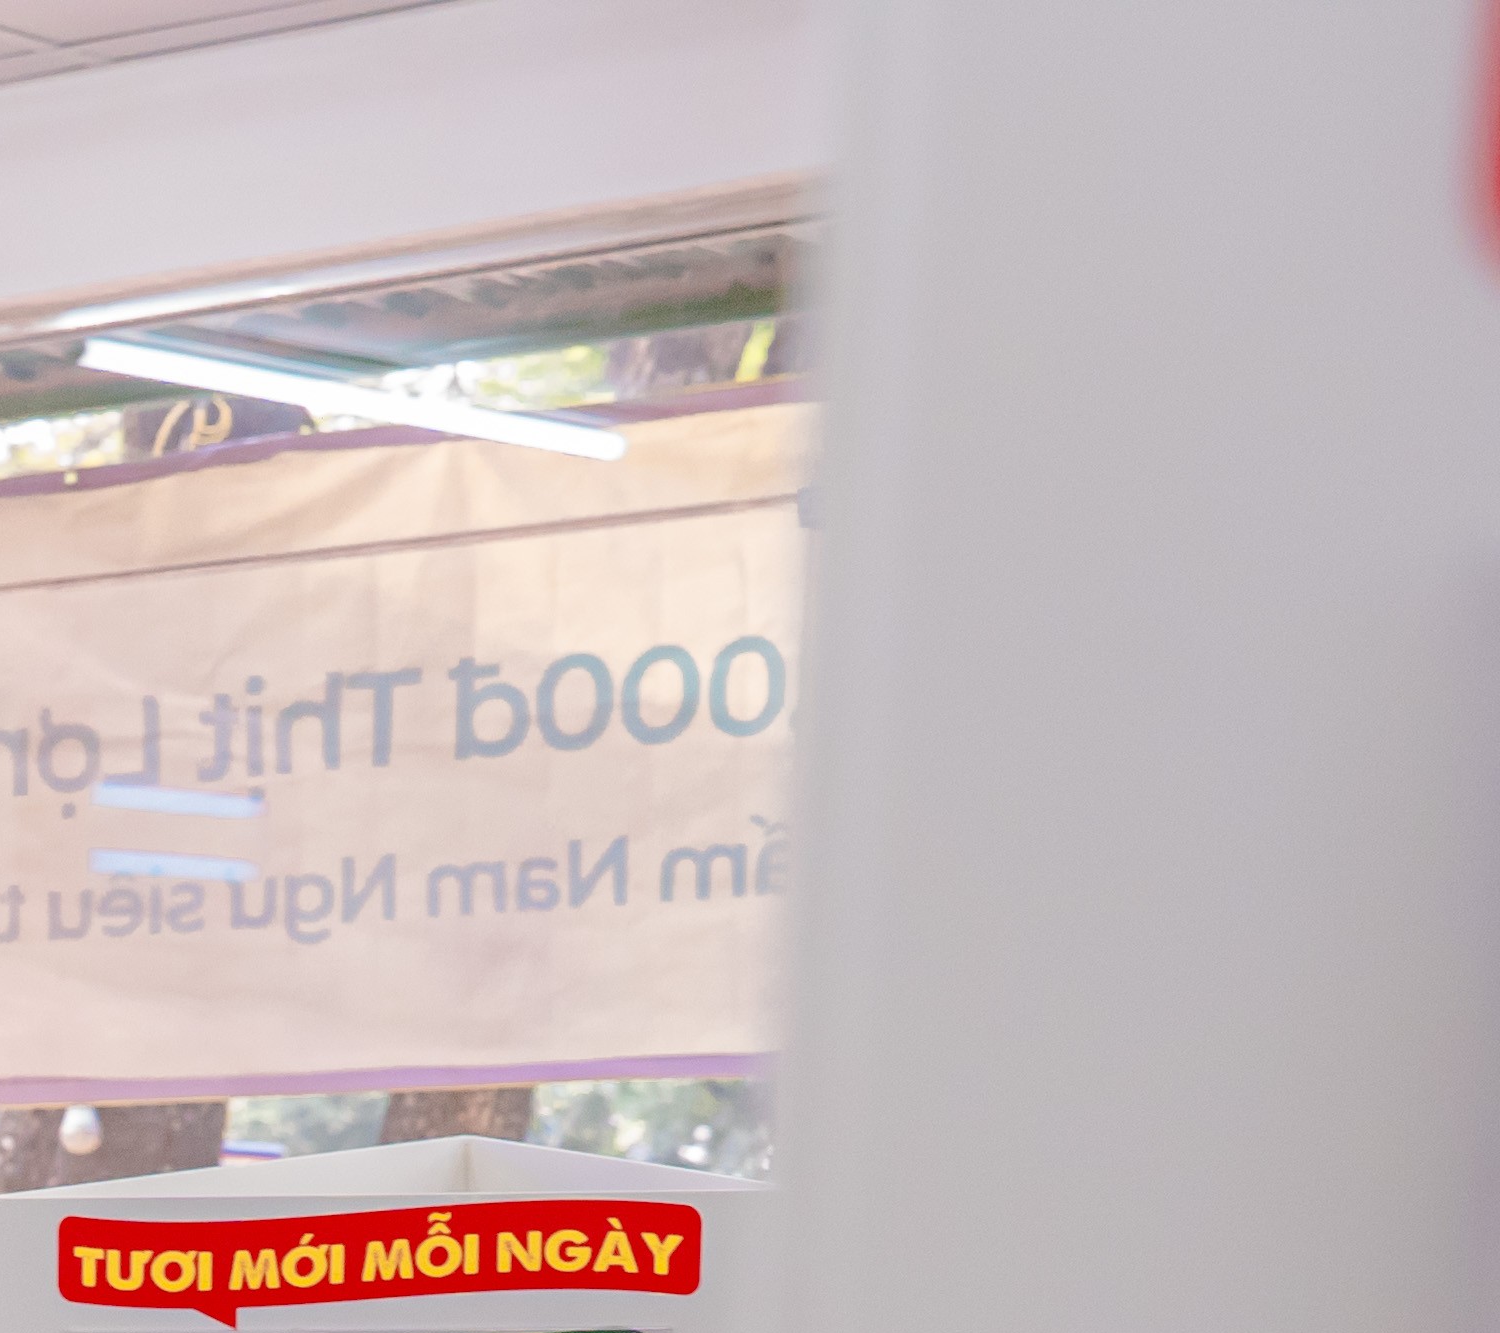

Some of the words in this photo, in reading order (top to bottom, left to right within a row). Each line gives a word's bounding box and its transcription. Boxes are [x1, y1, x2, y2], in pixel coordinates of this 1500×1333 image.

[72, 1243, 214, 1293] TƯƠI
[229, 1233, 345, 1292] MỚI
[360, 1211, 481, 1283] MỖI
[496, 1214, 685, 1277] NGÀY
